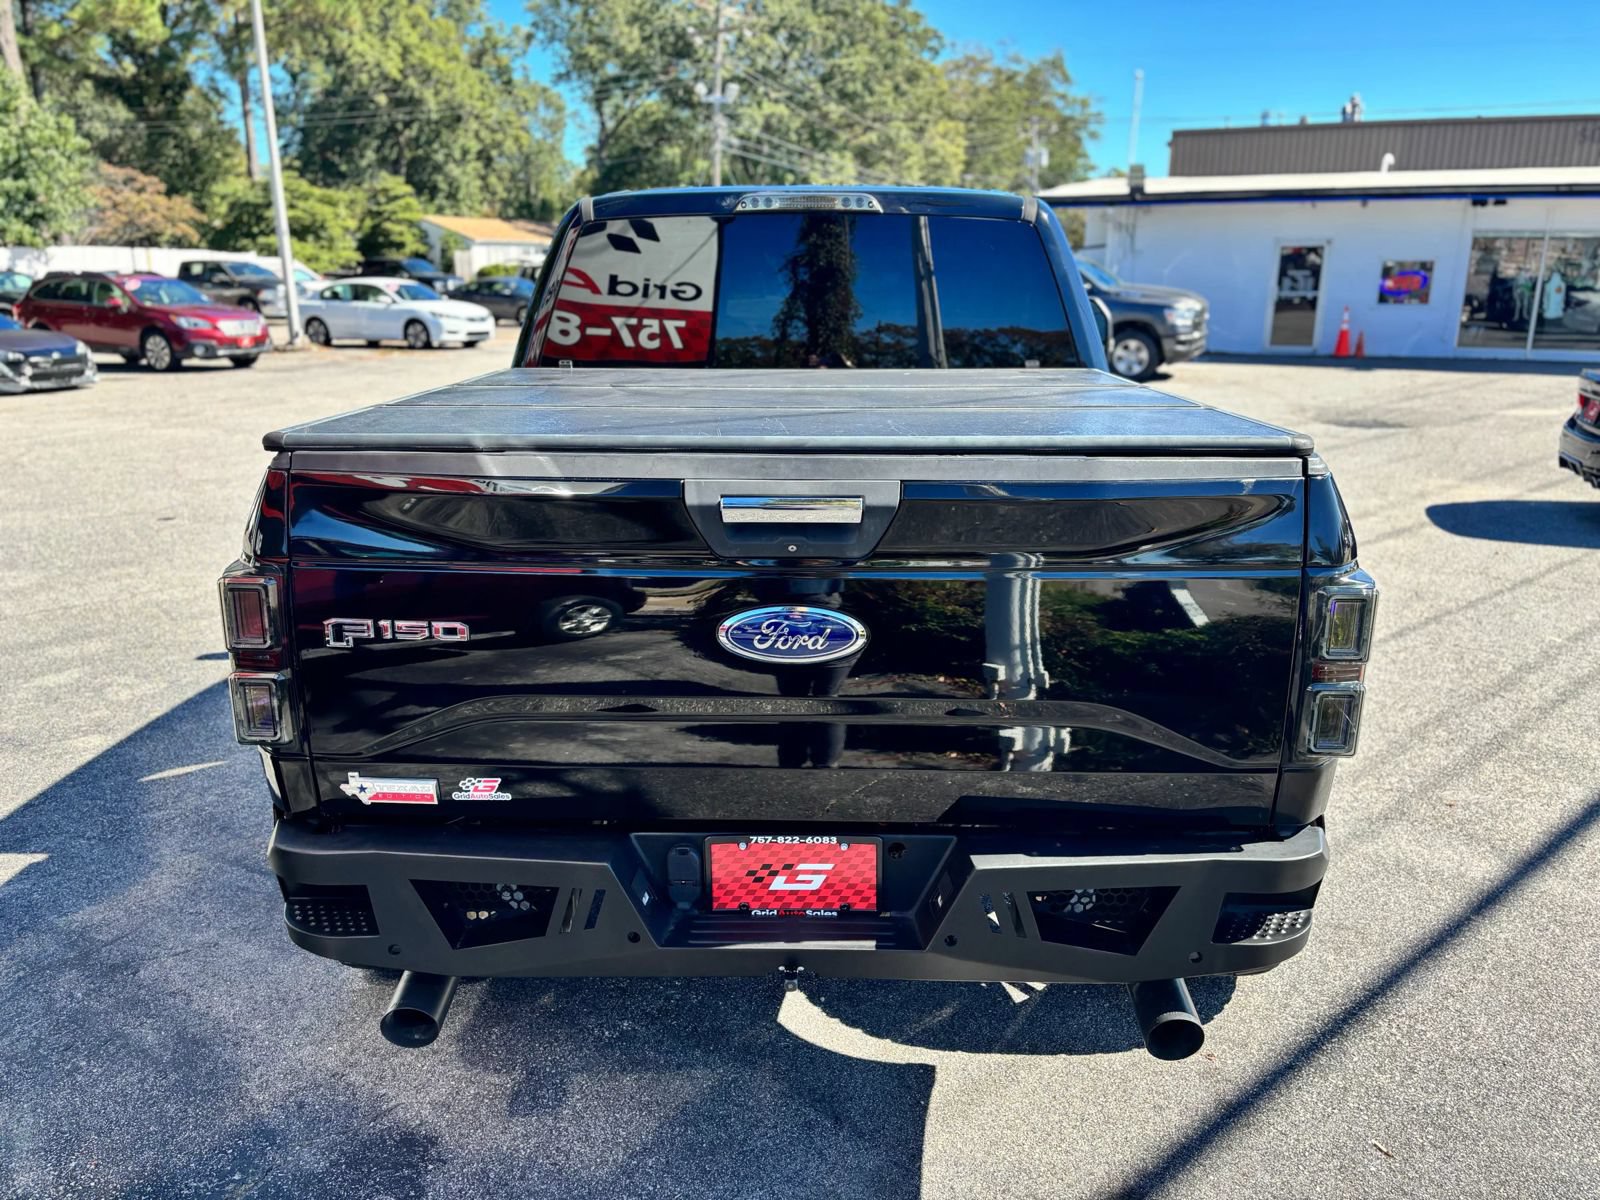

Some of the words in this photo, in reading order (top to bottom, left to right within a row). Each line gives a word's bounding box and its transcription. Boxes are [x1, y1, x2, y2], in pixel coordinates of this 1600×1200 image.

[753, 619, 832, 650] Ford
[375, 784, 432, 793] TEXAS
[453, 792, 510, 800] GridAutoSales
[750, 836, 837, 844] 757-822-6083
